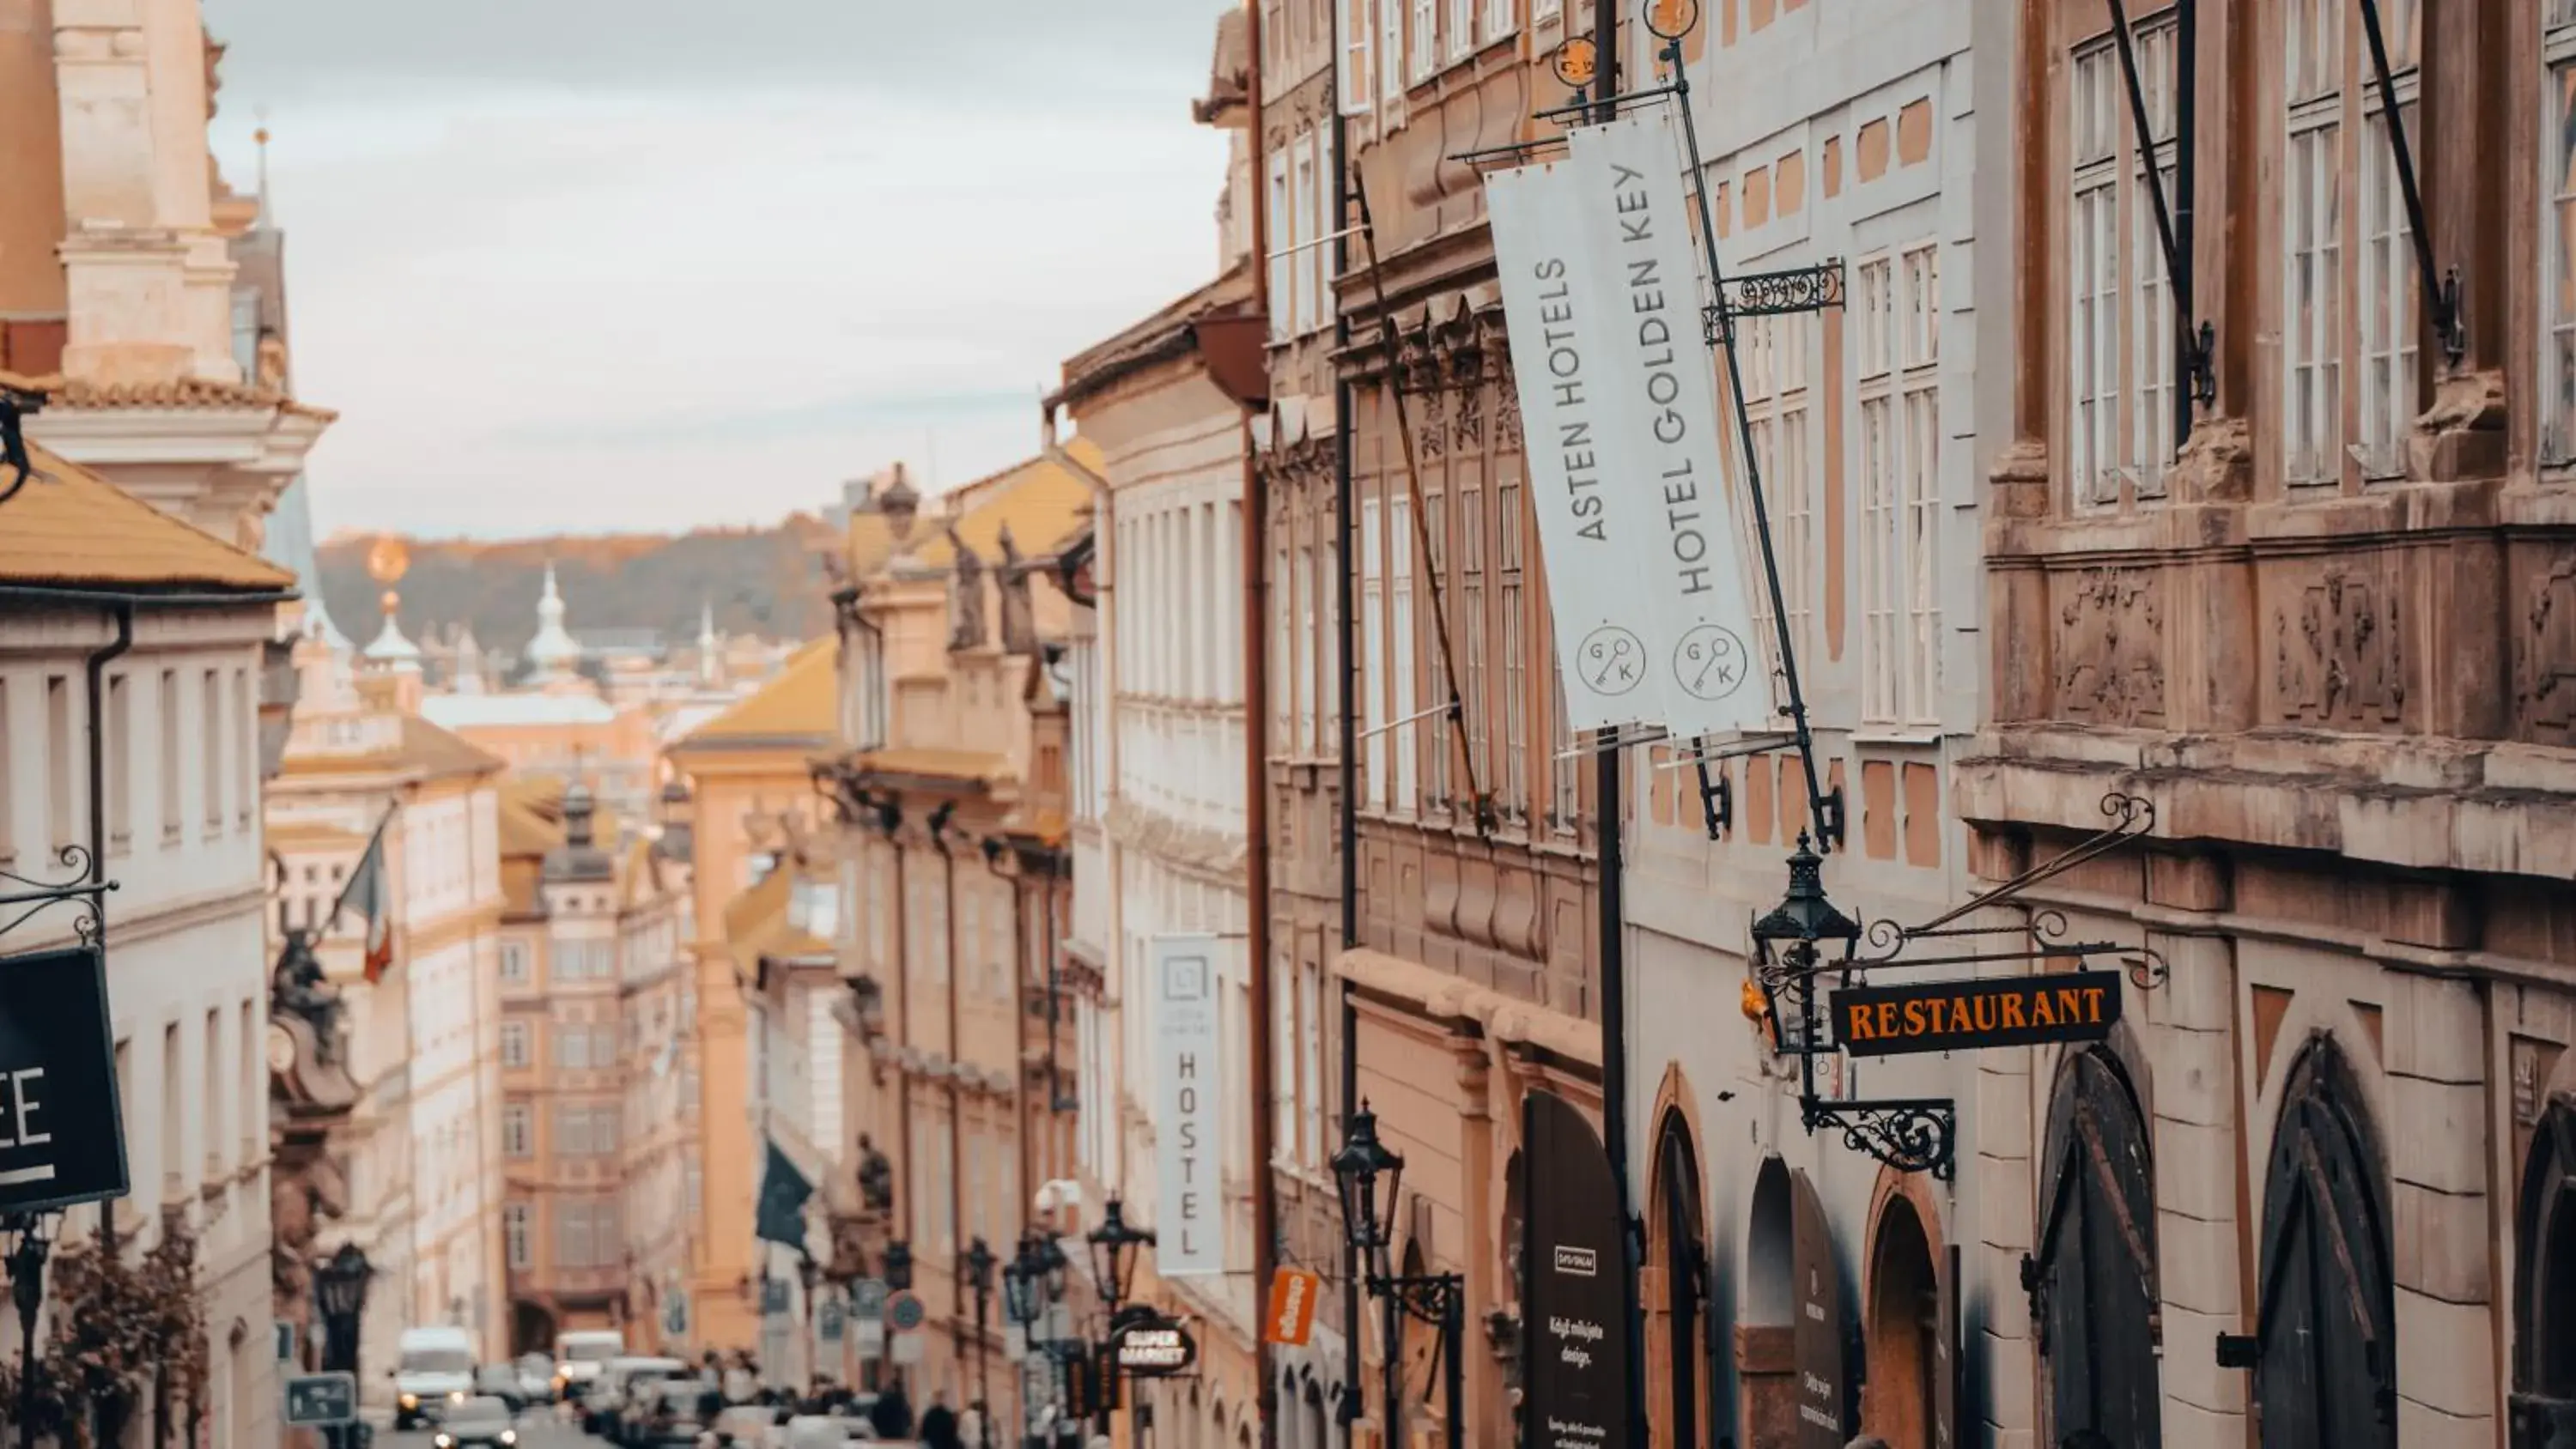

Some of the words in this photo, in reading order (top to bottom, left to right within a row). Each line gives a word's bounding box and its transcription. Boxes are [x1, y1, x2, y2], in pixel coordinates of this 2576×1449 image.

[1610, 163, 1654, 243] KEY
[1534, 258, 1585, 408] HOTELS
[1627, 258, 1686, 444] GOLDEN
[1559, 421, 1607, 542] ASTEN
[1662, 458, 1713, 596] HOTEL
[1589, 643, 1603, 659] G
[1619, 664, 1633, 681] K
[1687, 642, 1701, 660] G
[1717, 664, 1735, 684] K
[1848, 988, 2105, 1040] RESTAURANT
[1179, 1052, 1199, 1256] HOSTEL
[1119, 1347, 1187, 1365] MARKET
[1125, 1331, 1180, 1347] SUPER
